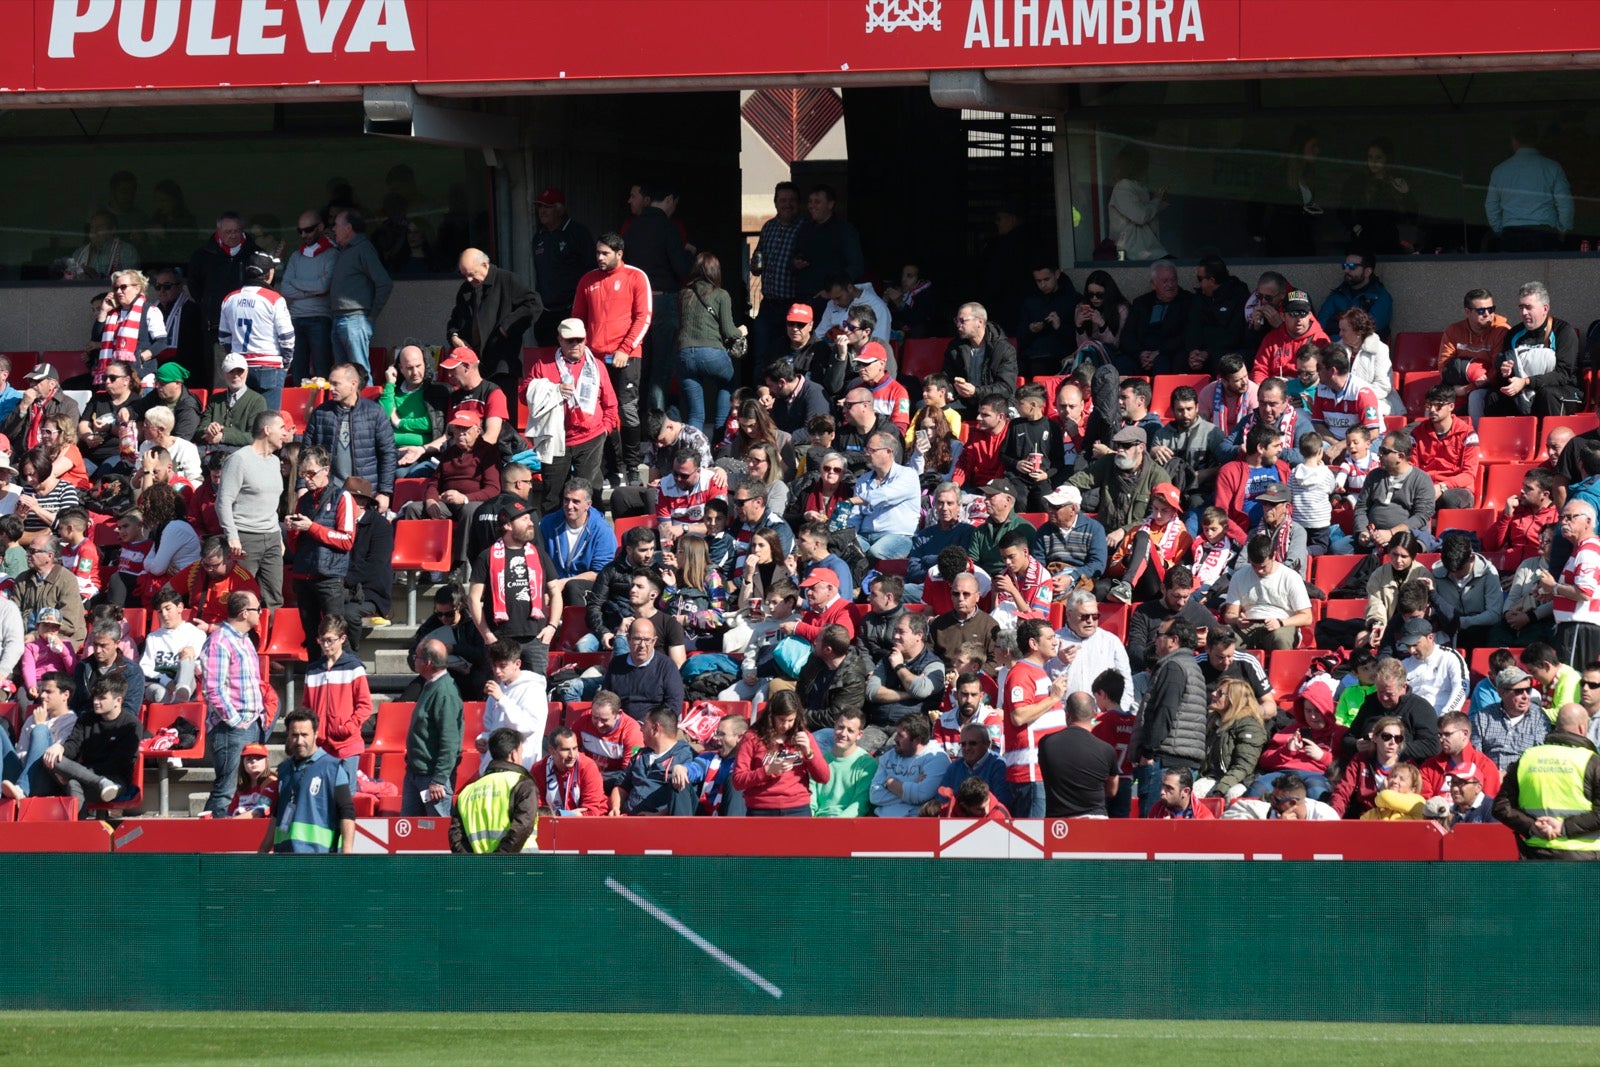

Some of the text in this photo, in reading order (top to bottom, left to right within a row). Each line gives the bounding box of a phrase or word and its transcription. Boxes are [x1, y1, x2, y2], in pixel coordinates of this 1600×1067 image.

[47, 0, 416, 58] PULEVA
[963, 0, 1205, 49] ALHAMBRA
[236, 298, 256, 309] MANU
[237, 317, 253, 353] 7
[1115, 742, 1129, 774] 7
[1528, 766, 1574, 775] SEGURIDAD
